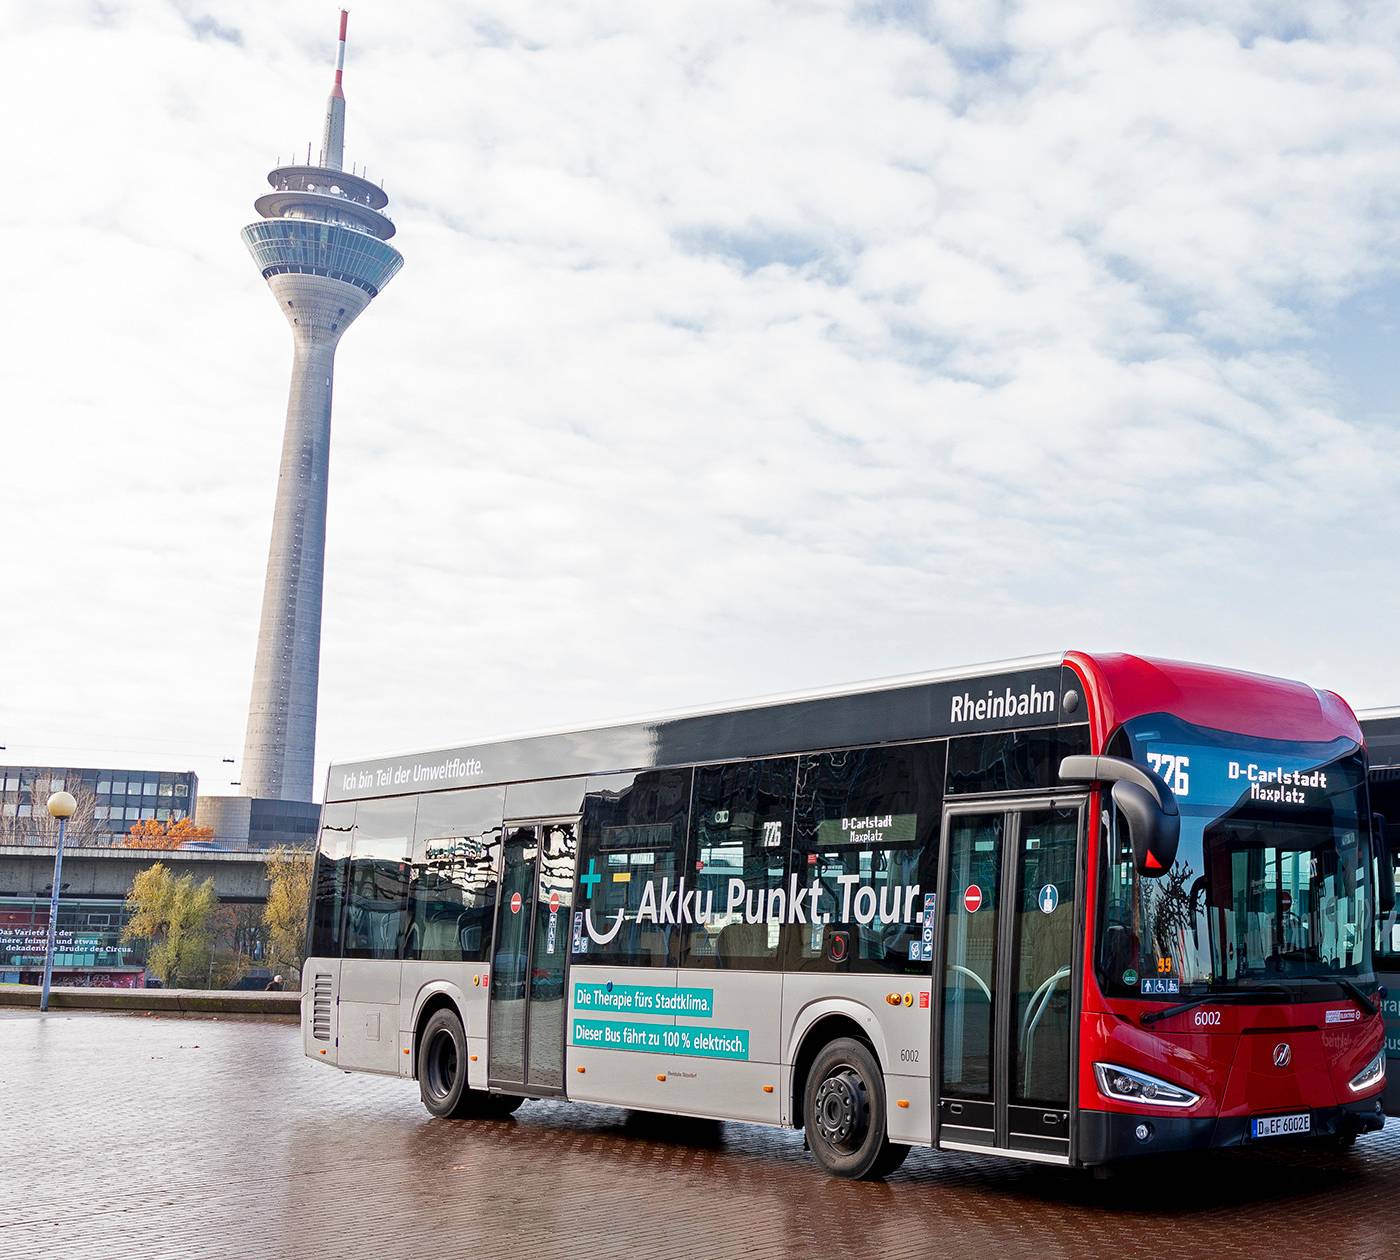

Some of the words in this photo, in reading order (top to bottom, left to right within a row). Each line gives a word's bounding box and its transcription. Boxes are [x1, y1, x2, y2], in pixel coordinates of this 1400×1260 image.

[951, 684, 1055, 723] Rheinbahn
[343, 772, 356, 791] Ich
[358, 769, 373, 788] bin
[376, 767, 393, 787] Teil
[394, 765, 411, 784] der
[413, 758, 484, 782] Umweltflotte.
[1228, 761, 1327, 789] D-Carlstadt
[1250, 782, 1305, 804] Maxplatz
[841, 815, 893, 830] D-Carlstadt
[763, 821, 782, 847] 726
[850, 830, 883, 843] Maxplatz
[576, 989, 591, 1004] Die
[593, 990, 632, 1010] Therapie
[634, 992, 653, 1008] fürs
[655, 993, 710, 1011] Stadtklima.
[1194, 1011, 1221, 1026] 6002
[575, 1025, 603, 1041] Dieser
[605, 1027, 621, 1043] Bus
[623, 1028, 647, 1045] fährt
[648, 1033, 660, 1046] zu
[662, 1031, 680, 1048] 100
[681, 1033, 691, 1049] %
[693, 1034, 746, 1053] elektrisch.
[900, 1049, 920, 1063] 6002
[1258, 1120, 1264, 1135] D
[1270, 1119, 1281, 1133] EF
[1283, 1116, 1309, 1132] 6002E
